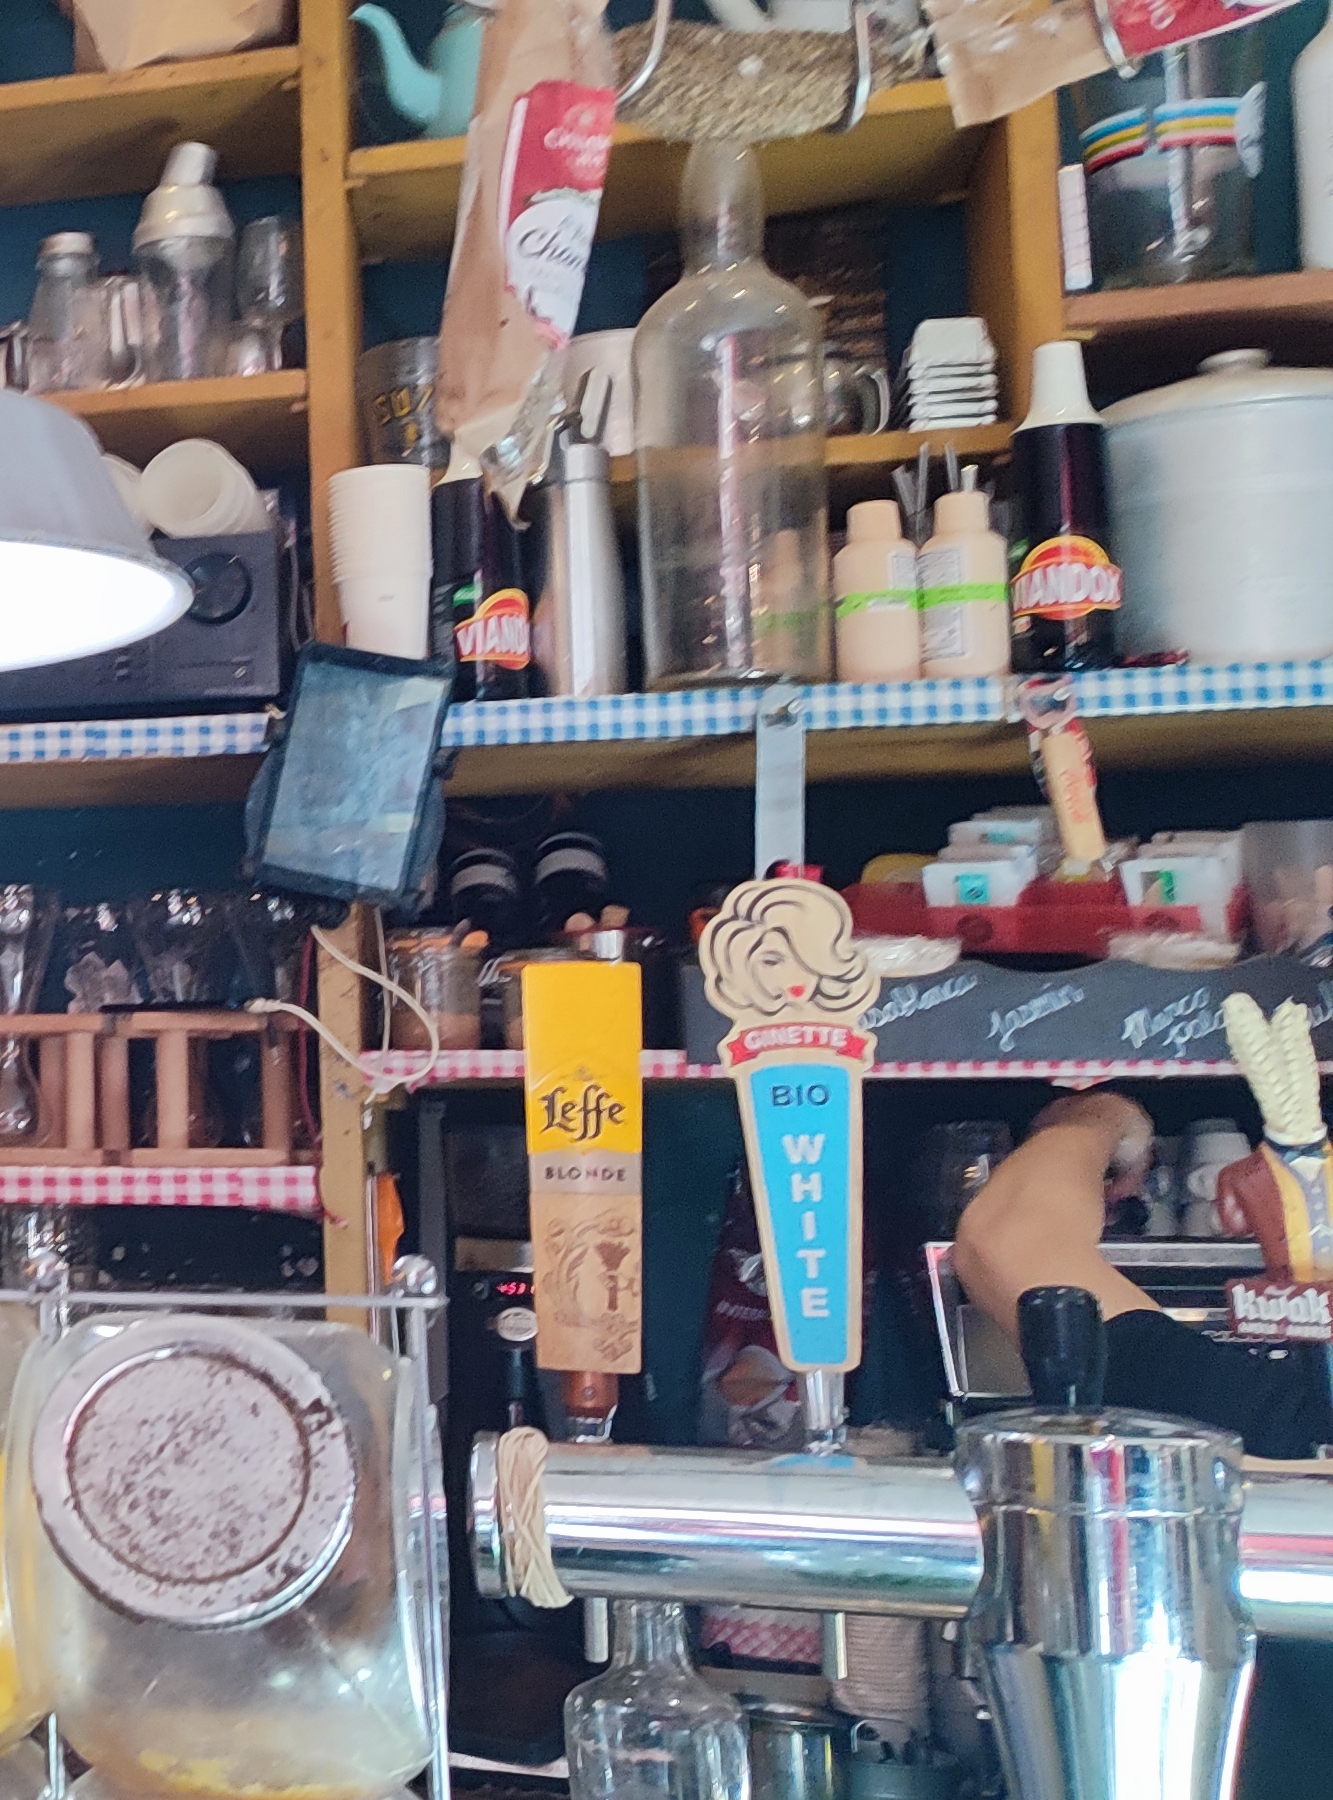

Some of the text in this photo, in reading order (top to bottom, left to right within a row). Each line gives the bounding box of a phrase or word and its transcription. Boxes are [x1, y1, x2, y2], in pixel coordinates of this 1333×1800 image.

[743, 1025, 848, 1051] GINETTE
[771, 1083, 831, 1108] BIO
[539, 1083, 625, 1143] Leffe
[544, 1164, 627, 1183] BLONDE
[781, 1133, 830, 1319] WHITE
